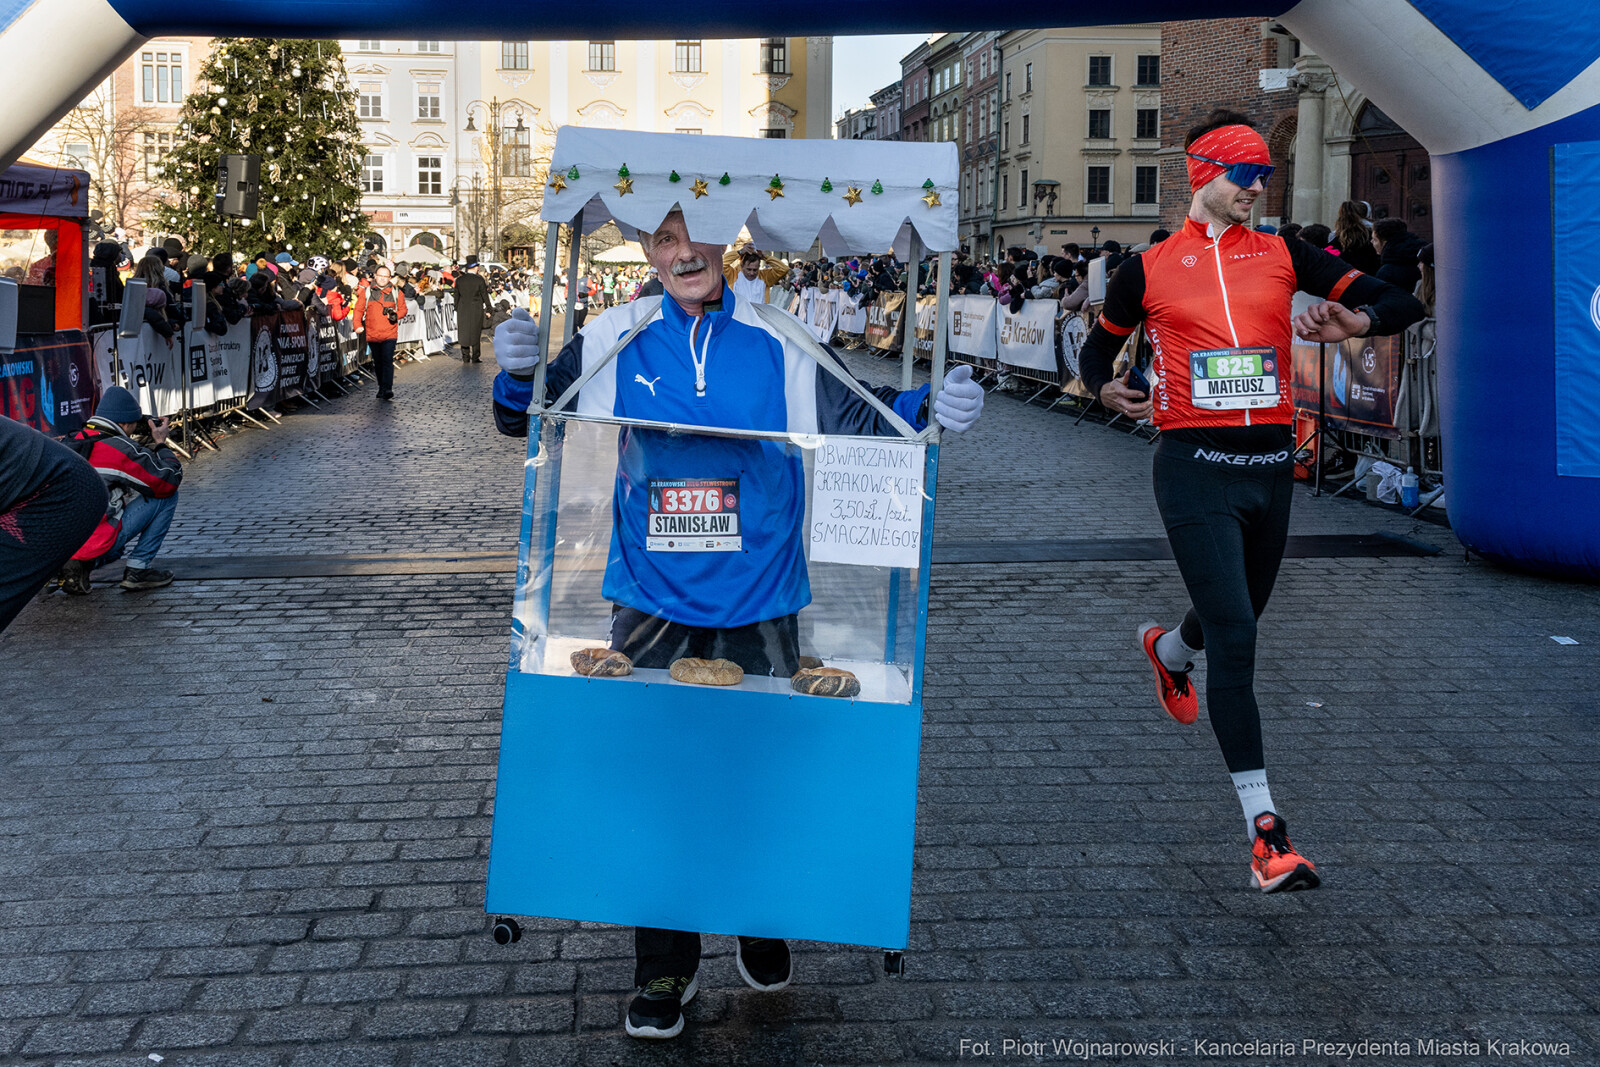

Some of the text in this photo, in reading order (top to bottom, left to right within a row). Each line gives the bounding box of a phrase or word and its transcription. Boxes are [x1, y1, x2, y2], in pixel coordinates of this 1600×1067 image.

[1013, 320, 1046, 345] Kraków
[1216, 356, 1255, 377] 825
[1208, 378, 1265, 395] MATEUSZ
[816, 444, 913, 469] OBWARZANKI
[1193, 448, 1289, 466] NIKE PRO
[815, 469, 919, 496] KRAKOWSKIE
[665, 490, 720, 512] 3376
[655, 515, 731, 533] STANISŁAW
[811, 521, 919, 549] SMACZNEGO!
